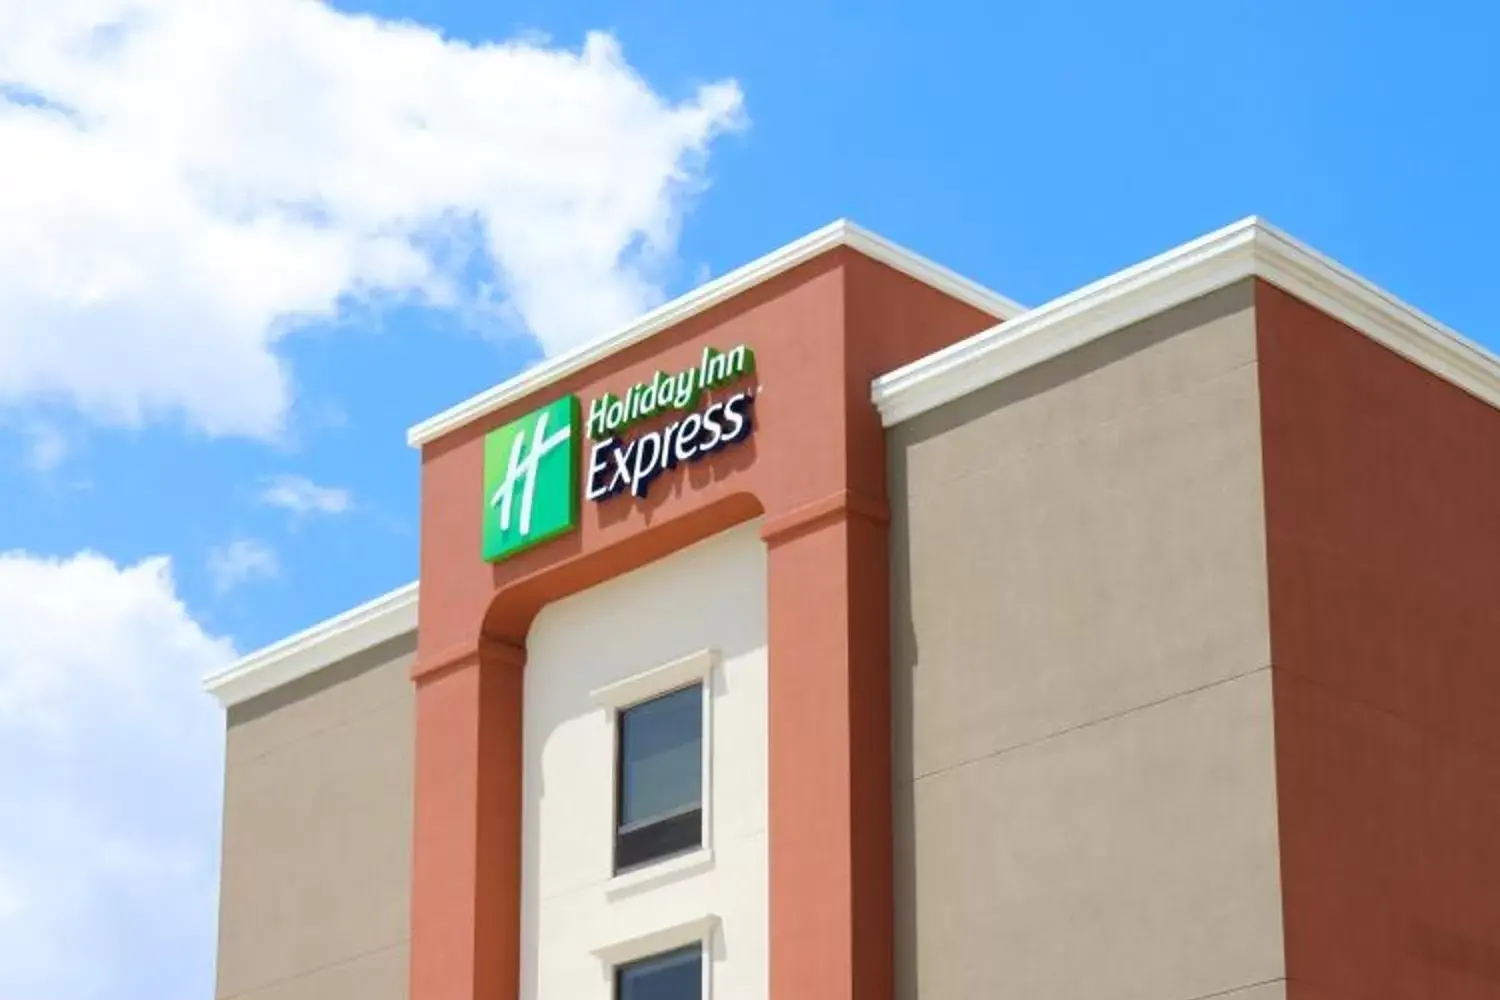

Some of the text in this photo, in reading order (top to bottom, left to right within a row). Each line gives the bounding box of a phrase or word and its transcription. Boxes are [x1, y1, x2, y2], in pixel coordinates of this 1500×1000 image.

[586, 344, 746, 438] Holiday Inn
[585, 393, 745, 500] Express
